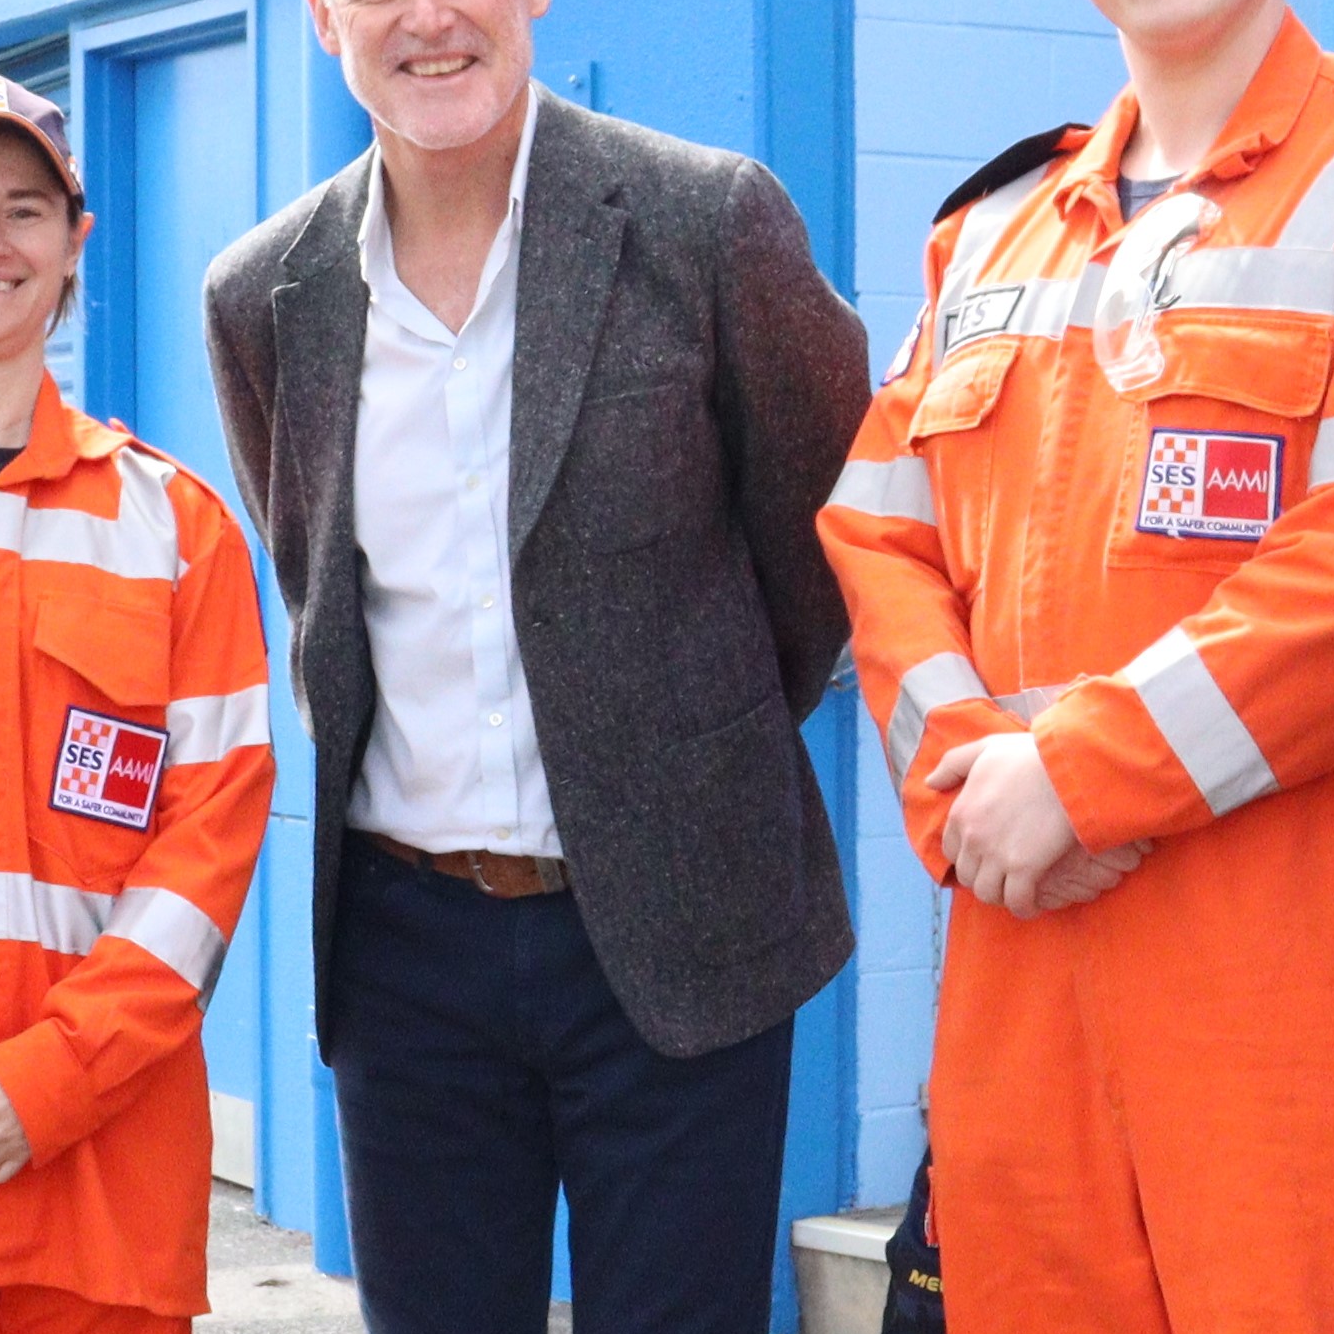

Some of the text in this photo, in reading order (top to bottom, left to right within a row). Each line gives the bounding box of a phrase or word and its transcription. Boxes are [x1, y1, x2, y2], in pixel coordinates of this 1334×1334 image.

[1150, 464, 1267, 493] SES AAMI
[1144, 516, 1267, 534] FOR A SAFER COMMUNITY
[65, 744, 154, 784] SES AAMI
[58, 794, 144, 823] FOR A SAFER COMMUNITY
[908, 1269, 944, 1292] ME
